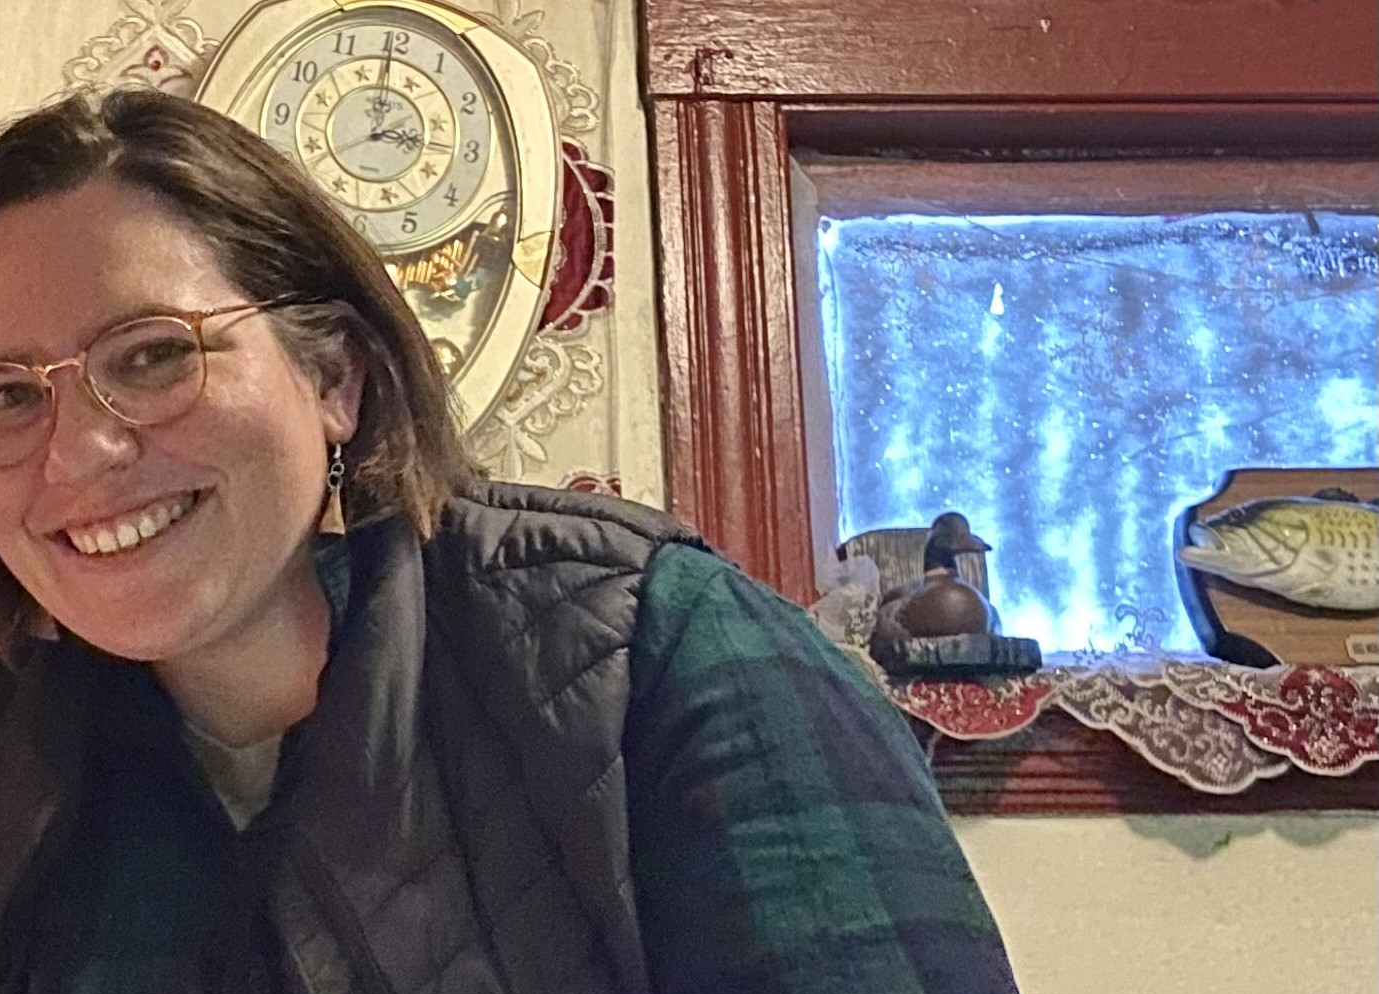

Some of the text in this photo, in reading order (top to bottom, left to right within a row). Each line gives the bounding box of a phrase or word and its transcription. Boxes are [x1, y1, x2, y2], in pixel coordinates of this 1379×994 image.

[332, 32, 356, 56] 11
[382, 31, 410, 55] 12
[291, 60, 318, 84] 10
[434, 51, 446, 74] 1
[274, 102, 290, 125] 9
[460, 91, 477, 115] 2
[463, 140, 480, 163] 3
[443, 182, 459, 207] 4
[401, 211, 418, 234] 5
